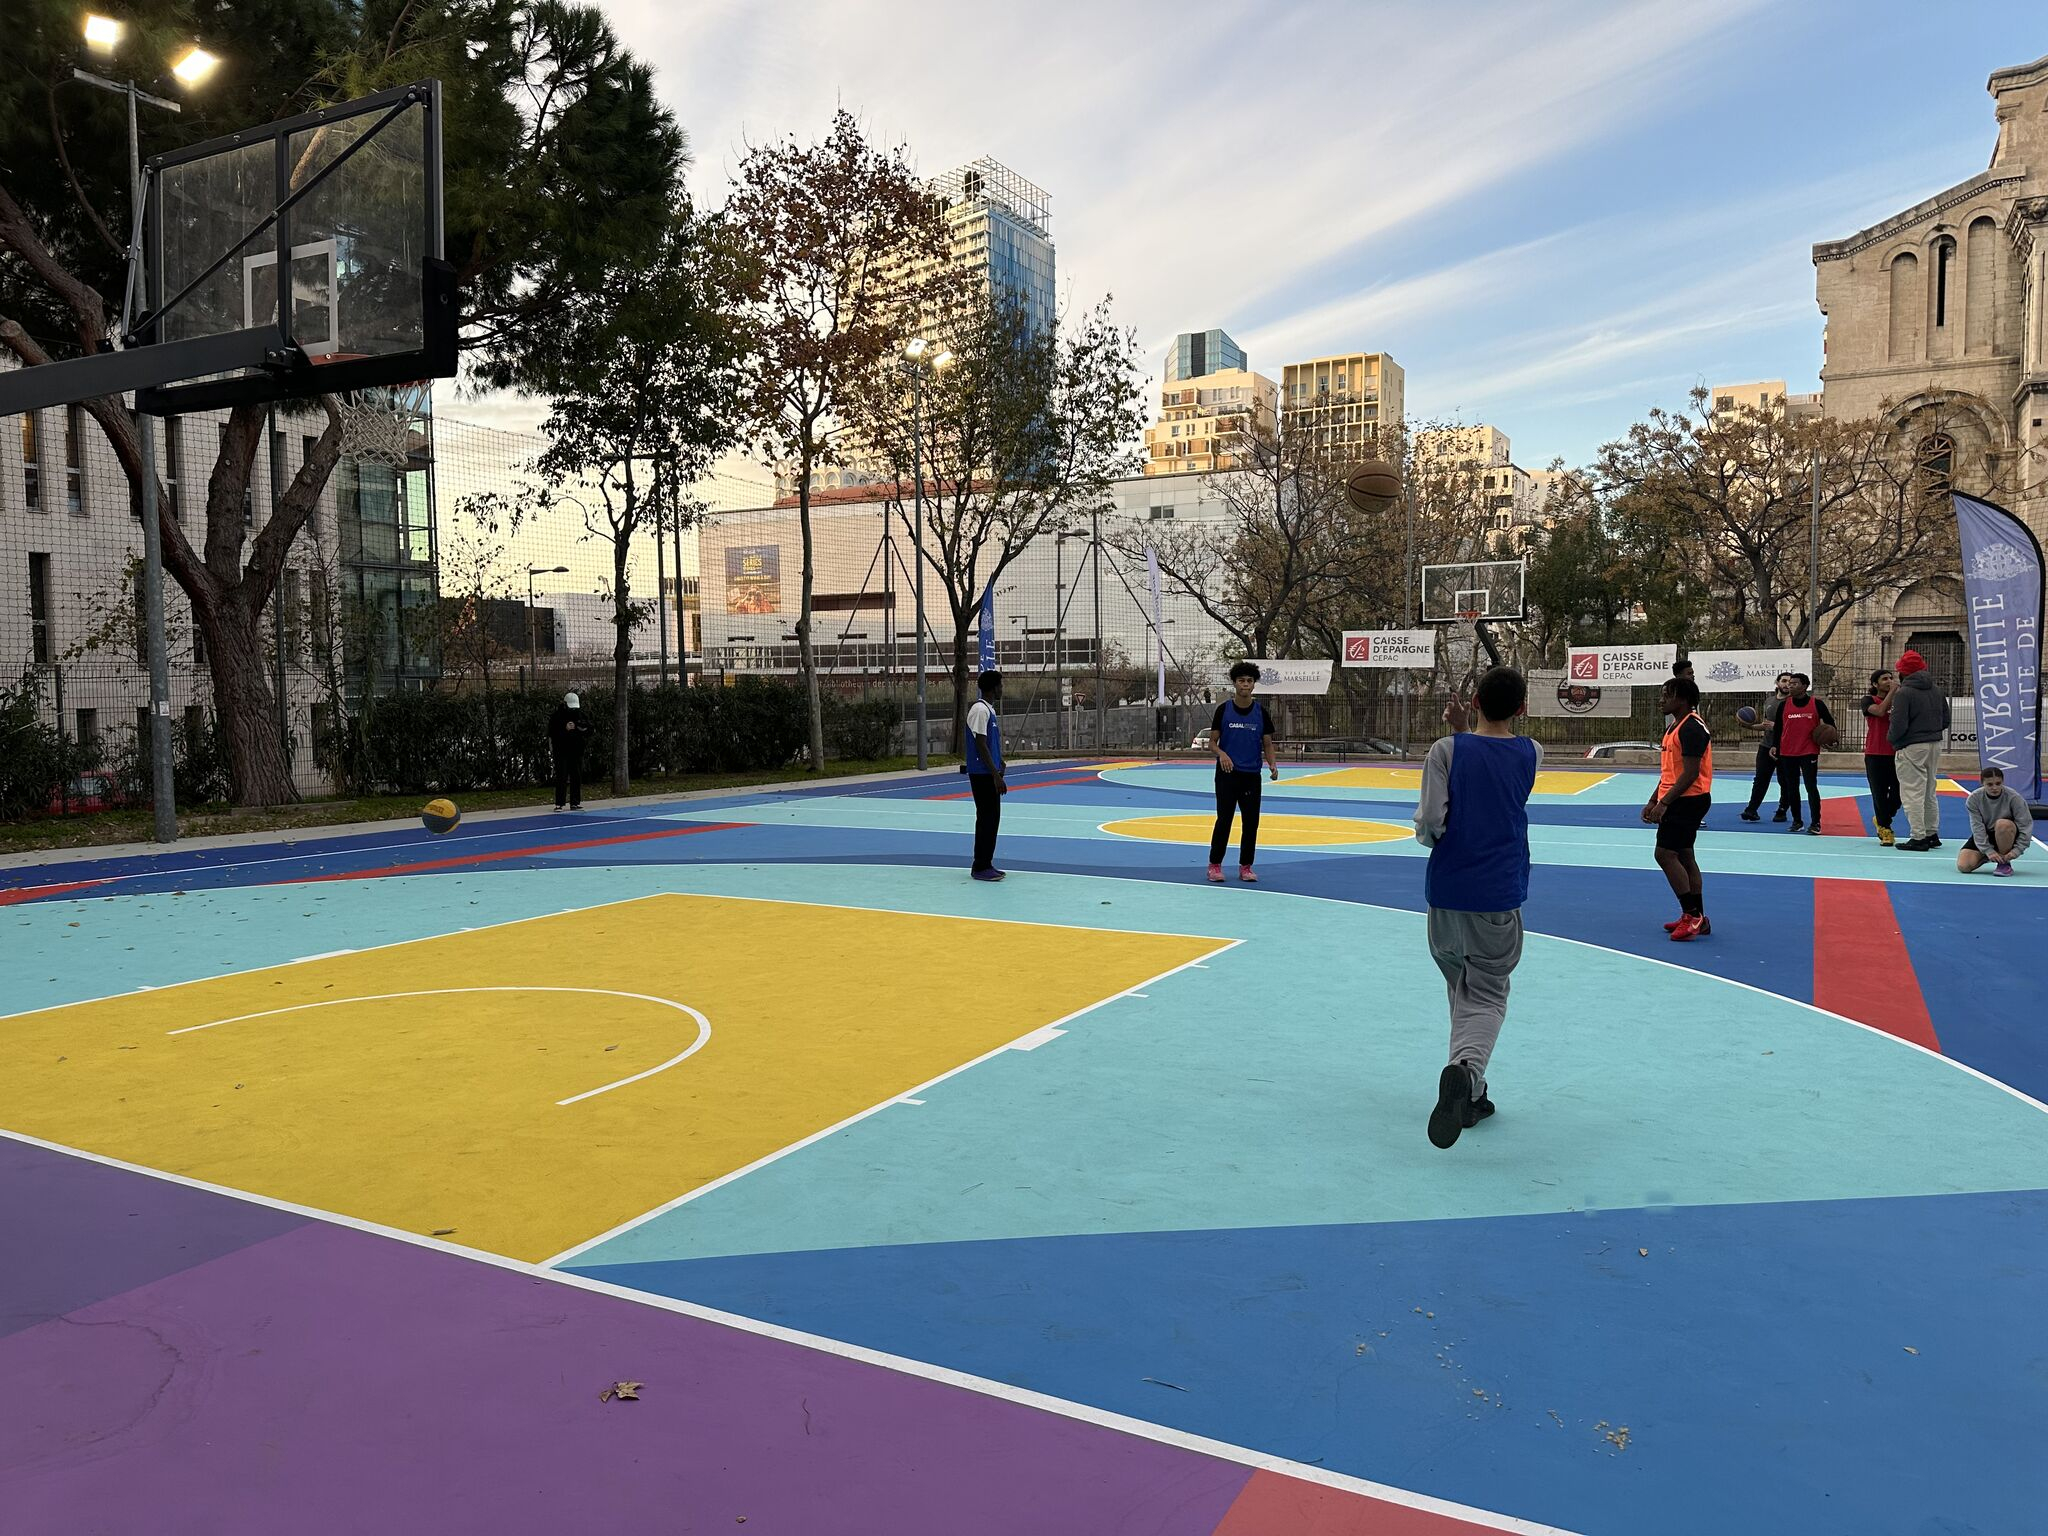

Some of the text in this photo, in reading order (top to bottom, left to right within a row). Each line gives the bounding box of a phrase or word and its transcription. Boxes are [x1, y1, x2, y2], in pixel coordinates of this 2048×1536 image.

[1373, 636, 1409, 645] CAISSE
[1373, 645, 1430, 654] D'EPARGNE
[1373, 654, 1398, 662] CEPAC
[1602, 652, 1644, 662] CAISSE
[1602, 661, 1669, 671] D'EPARGNE
[1602, 672, 1633, 680] CEPAC
